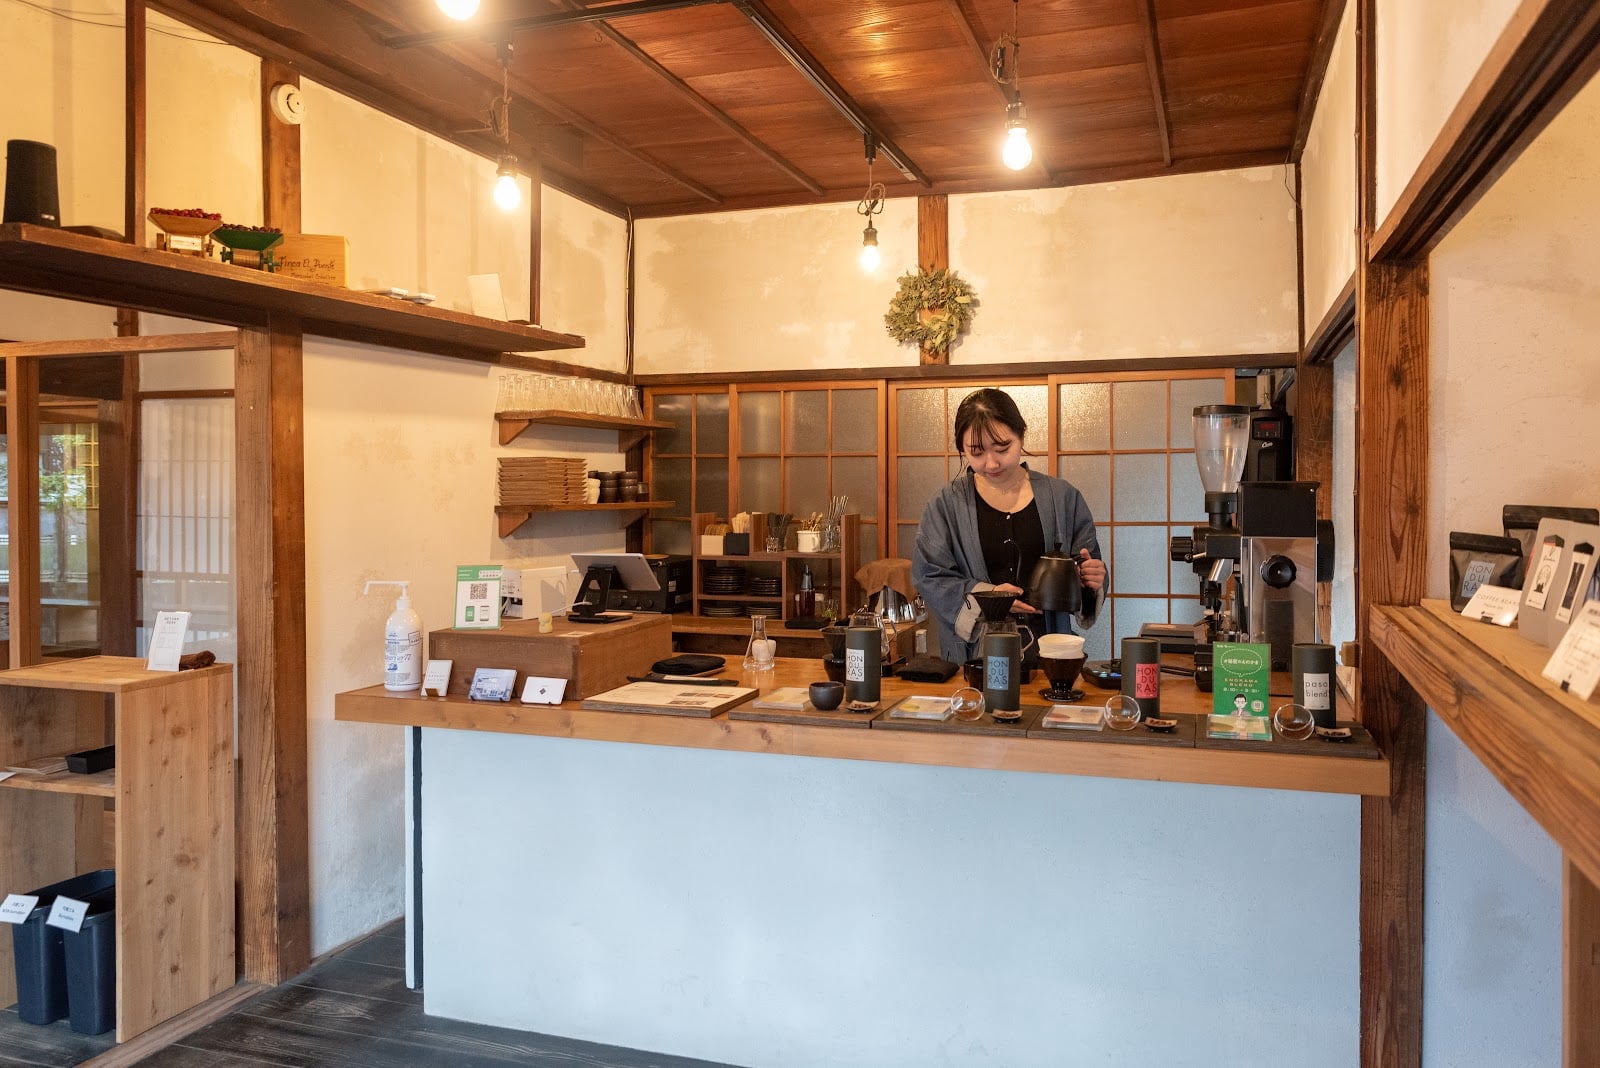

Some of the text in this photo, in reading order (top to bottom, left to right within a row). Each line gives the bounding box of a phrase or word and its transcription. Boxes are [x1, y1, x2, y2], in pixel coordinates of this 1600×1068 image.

[1470, 564, 1492, 574] HON
[1470, 573, 1485, 583] DU
[1464, 580, 1478, 591] RA
[991, 668, 1003, 676] DU
[1137, 667, 1157, 675] HON
[1141, 675, 1155, 683] DU
[1136, 683, 1157, 692] RAS
[1305, 689, 1328, 697] blend
